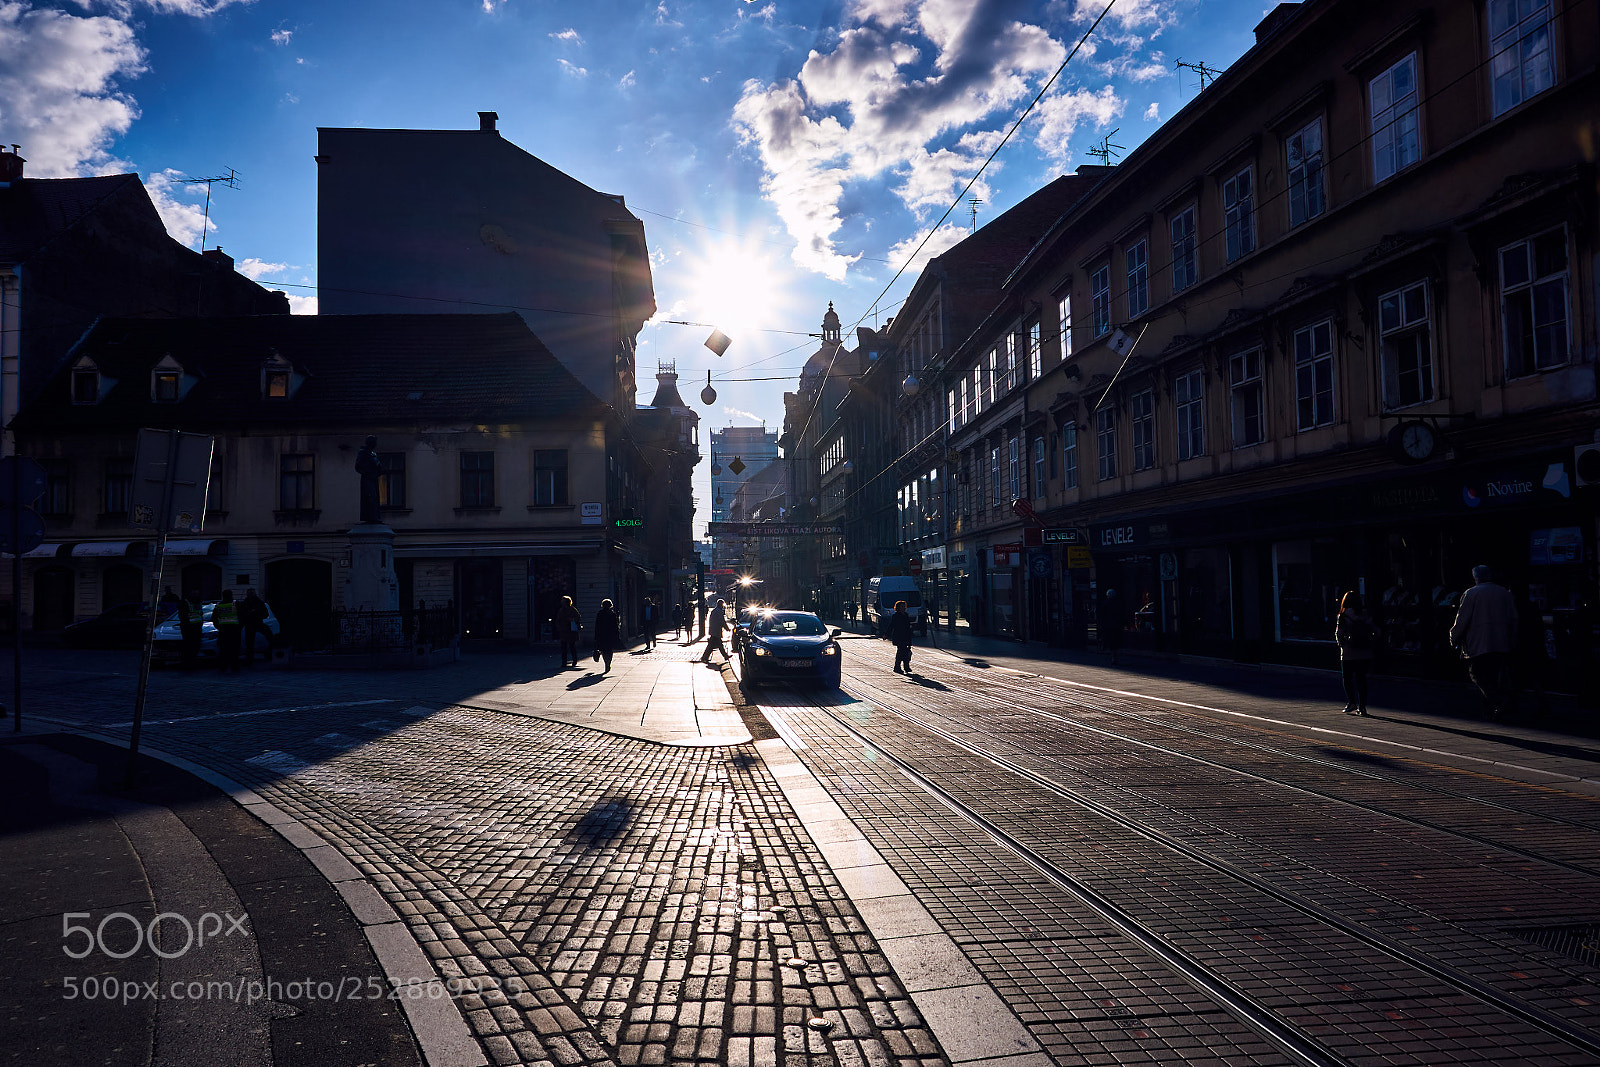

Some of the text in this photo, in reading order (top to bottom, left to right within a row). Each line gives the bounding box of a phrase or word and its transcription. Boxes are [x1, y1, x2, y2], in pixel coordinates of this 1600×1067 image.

[1487, 480, 1533, 497] iNovine
[1046, 532, 1076, 541] LEVEL2
[1101, 526, 1134, 546] LEVEL2
